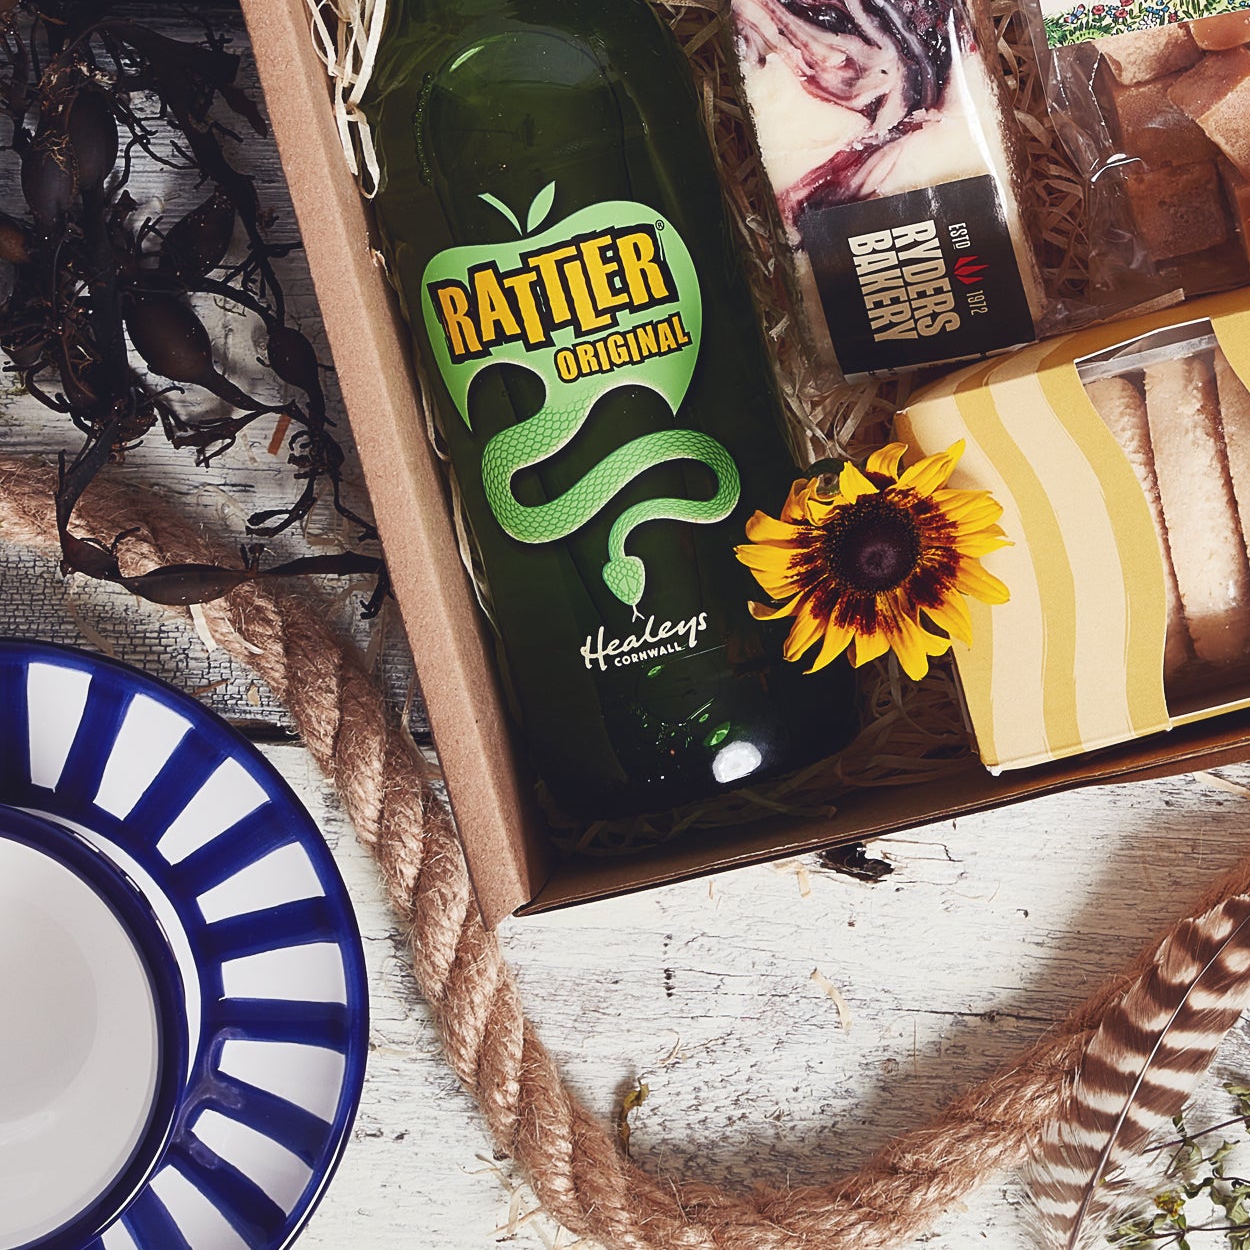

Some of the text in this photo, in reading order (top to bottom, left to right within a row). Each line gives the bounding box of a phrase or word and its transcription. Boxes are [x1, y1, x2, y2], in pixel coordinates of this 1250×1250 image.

[434, 230, 672, 359] RATTLER
[847, 229, 919, 343] BAKERY
[891, 219, 962, 337] RYDERS
[948, 222, 989, 316] ESTD 1972
[556, 314, 690, 382] ORIGINAL
[580, 611, 708, 672] Healeys
[614, 642, 683, 667] CORNWALL
